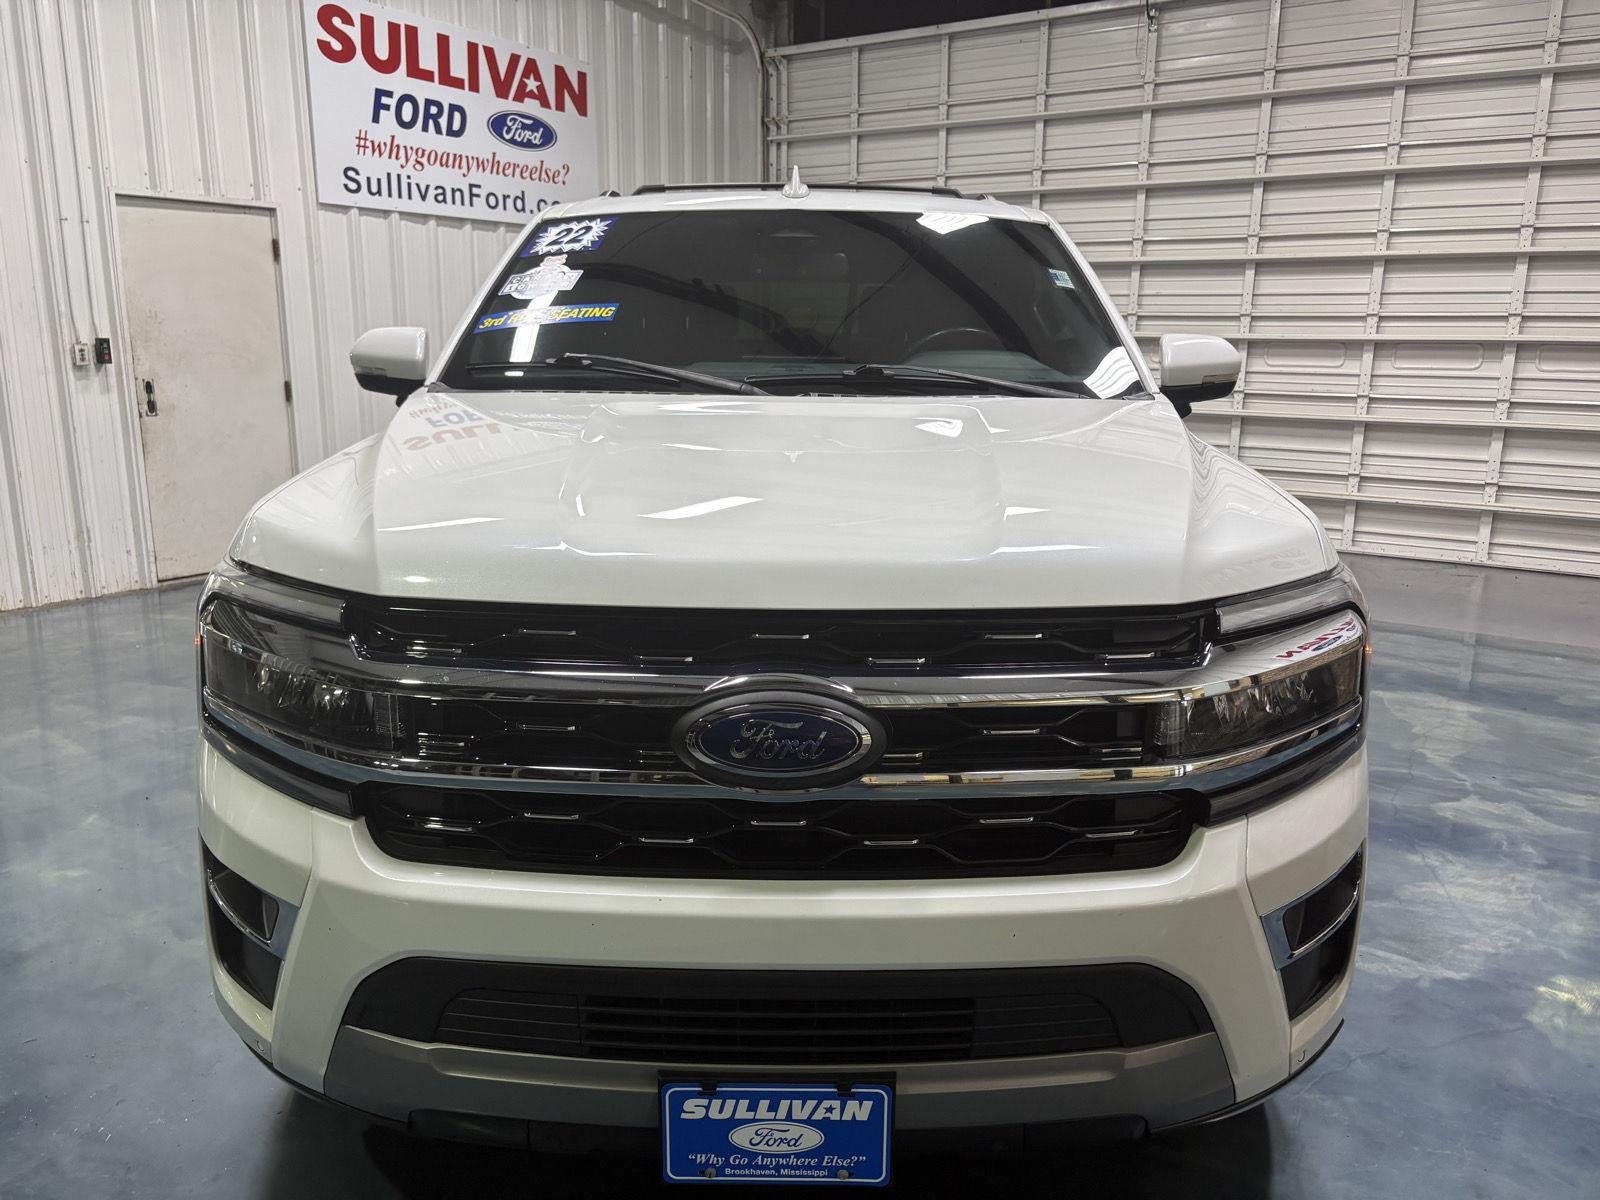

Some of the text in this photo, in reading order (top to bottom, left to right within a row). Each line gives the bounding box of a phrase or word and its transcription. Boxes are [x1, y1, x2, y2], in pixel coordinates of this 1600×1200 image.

[316, 3, 588, 118] SULLIVAN
[371, 87, 467, 139] FORD
[502, 114, 543, 146] Ford
[355, 129, 570, 186] #whygoanywhereelse?
[544, 225, 594, 248] 22
[479, 314, 508, 329] 3rd
[551, 306, 616, 321] SEATING
[729, 719, 827, 760] Ford
[680, 1098, 873, 1121] SULLIVAN
[748, 1127, 803, 1148] Ford
[729, 1154, 748, 1166] Go
[752, 1154, 818, 1167] Anywhere
[725, 1168, 828, 1177] Brookhaven, Mississippi
